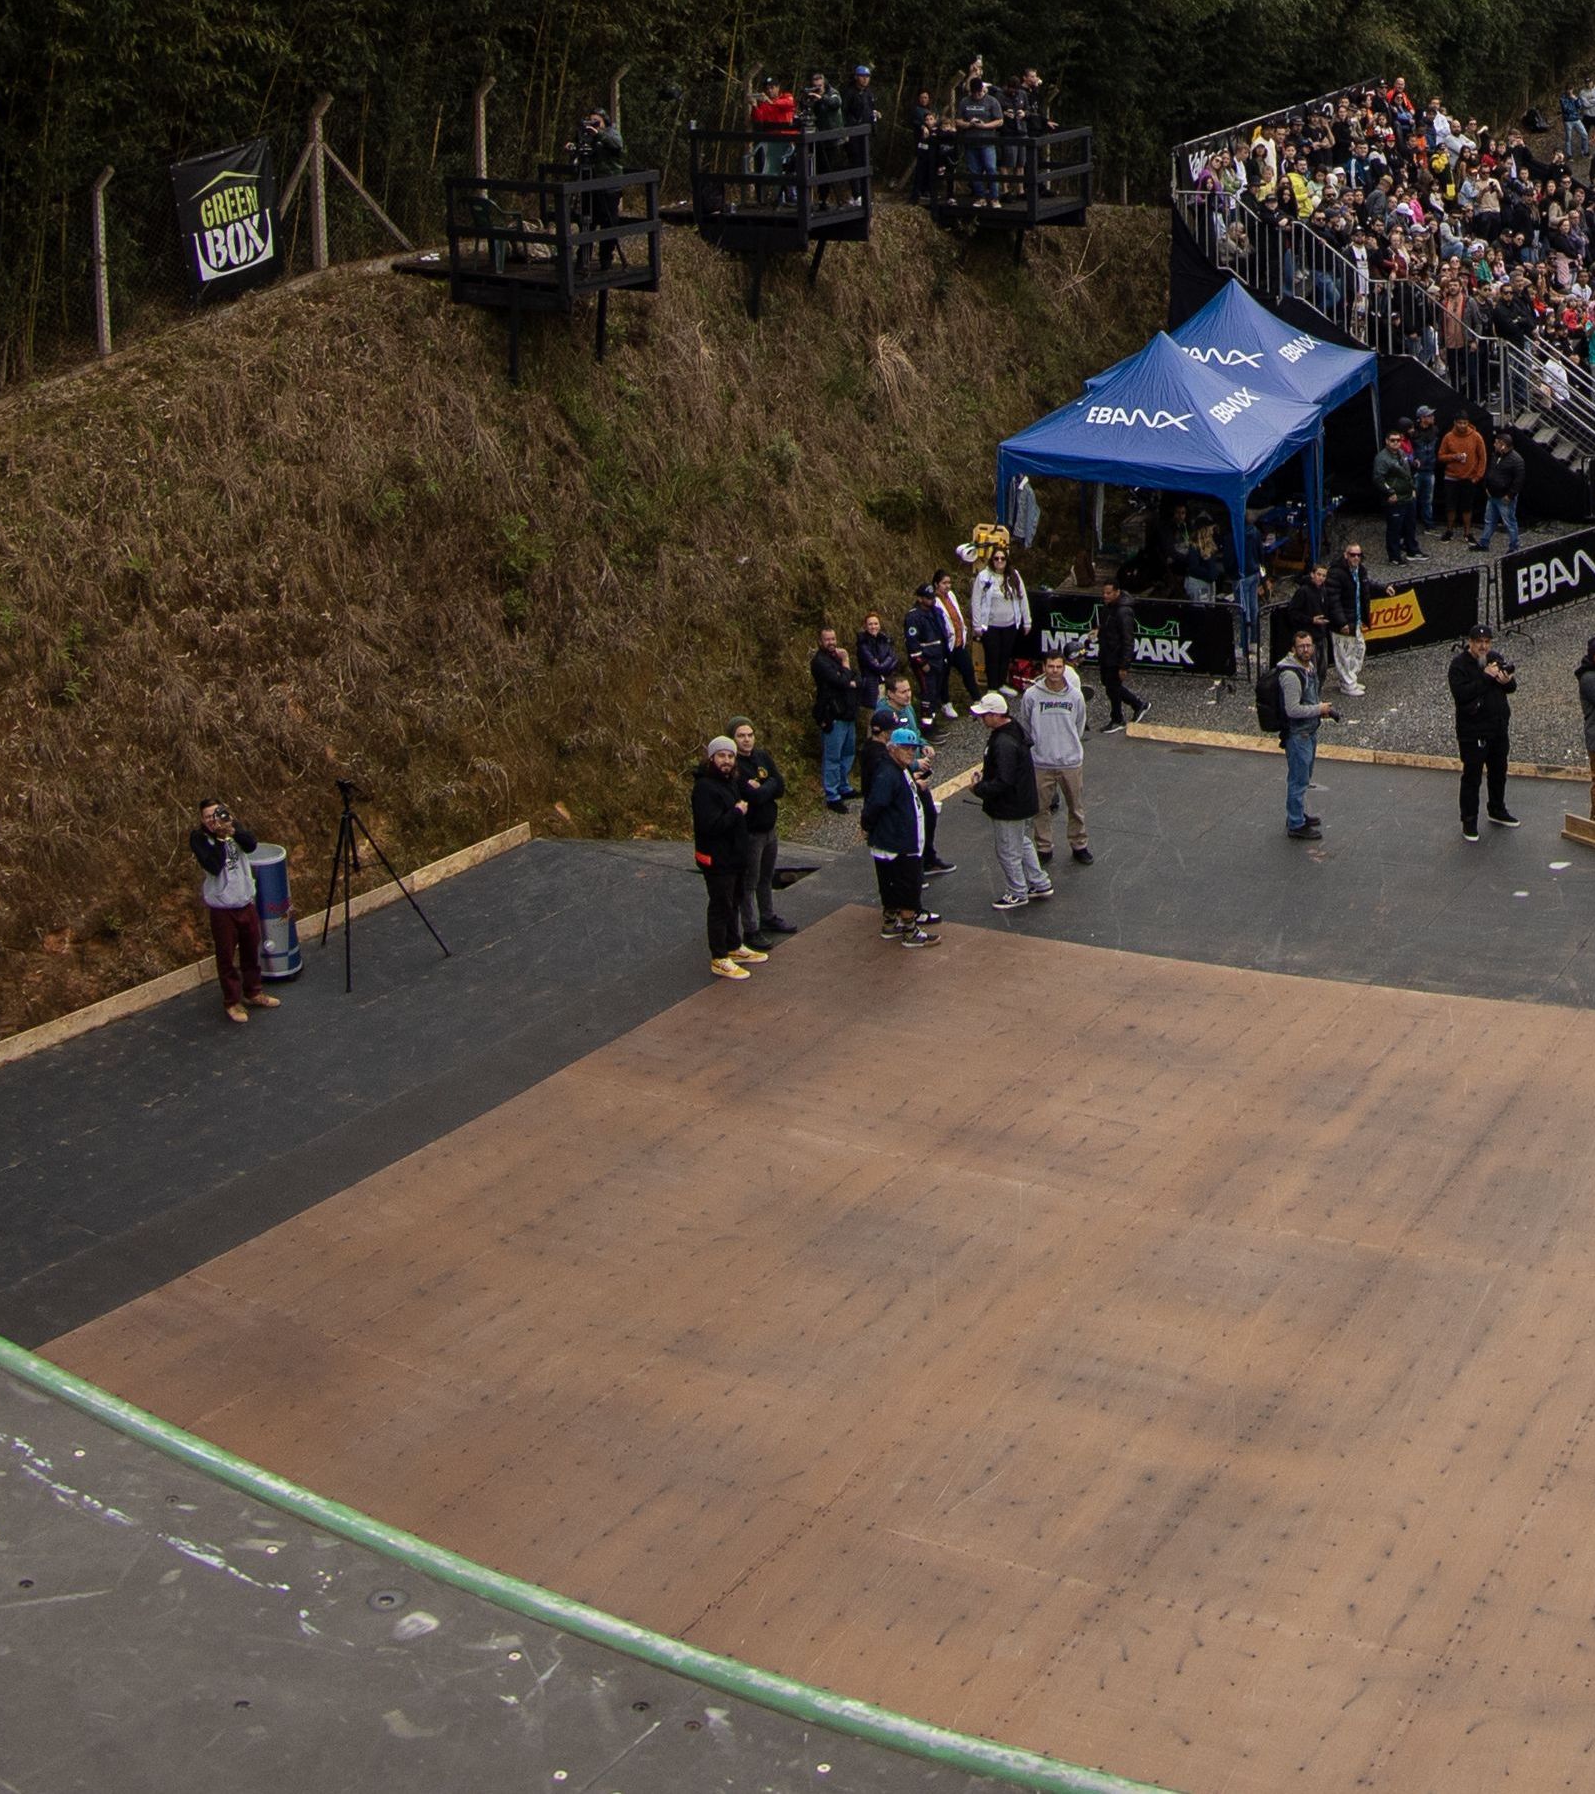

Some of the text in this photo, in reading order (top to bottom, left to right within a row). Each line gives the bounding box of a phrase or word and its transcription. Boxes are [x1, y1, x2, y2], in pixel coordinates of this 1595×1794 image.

[201, 186, 259, 228] GREEN
[205, 214, 265, 269] BOX
[1278, 334, 1323, 364] EBANX
[1086, 406, 1195, 432] EBANX
[1209, 387, 1261, 425] EBANX
